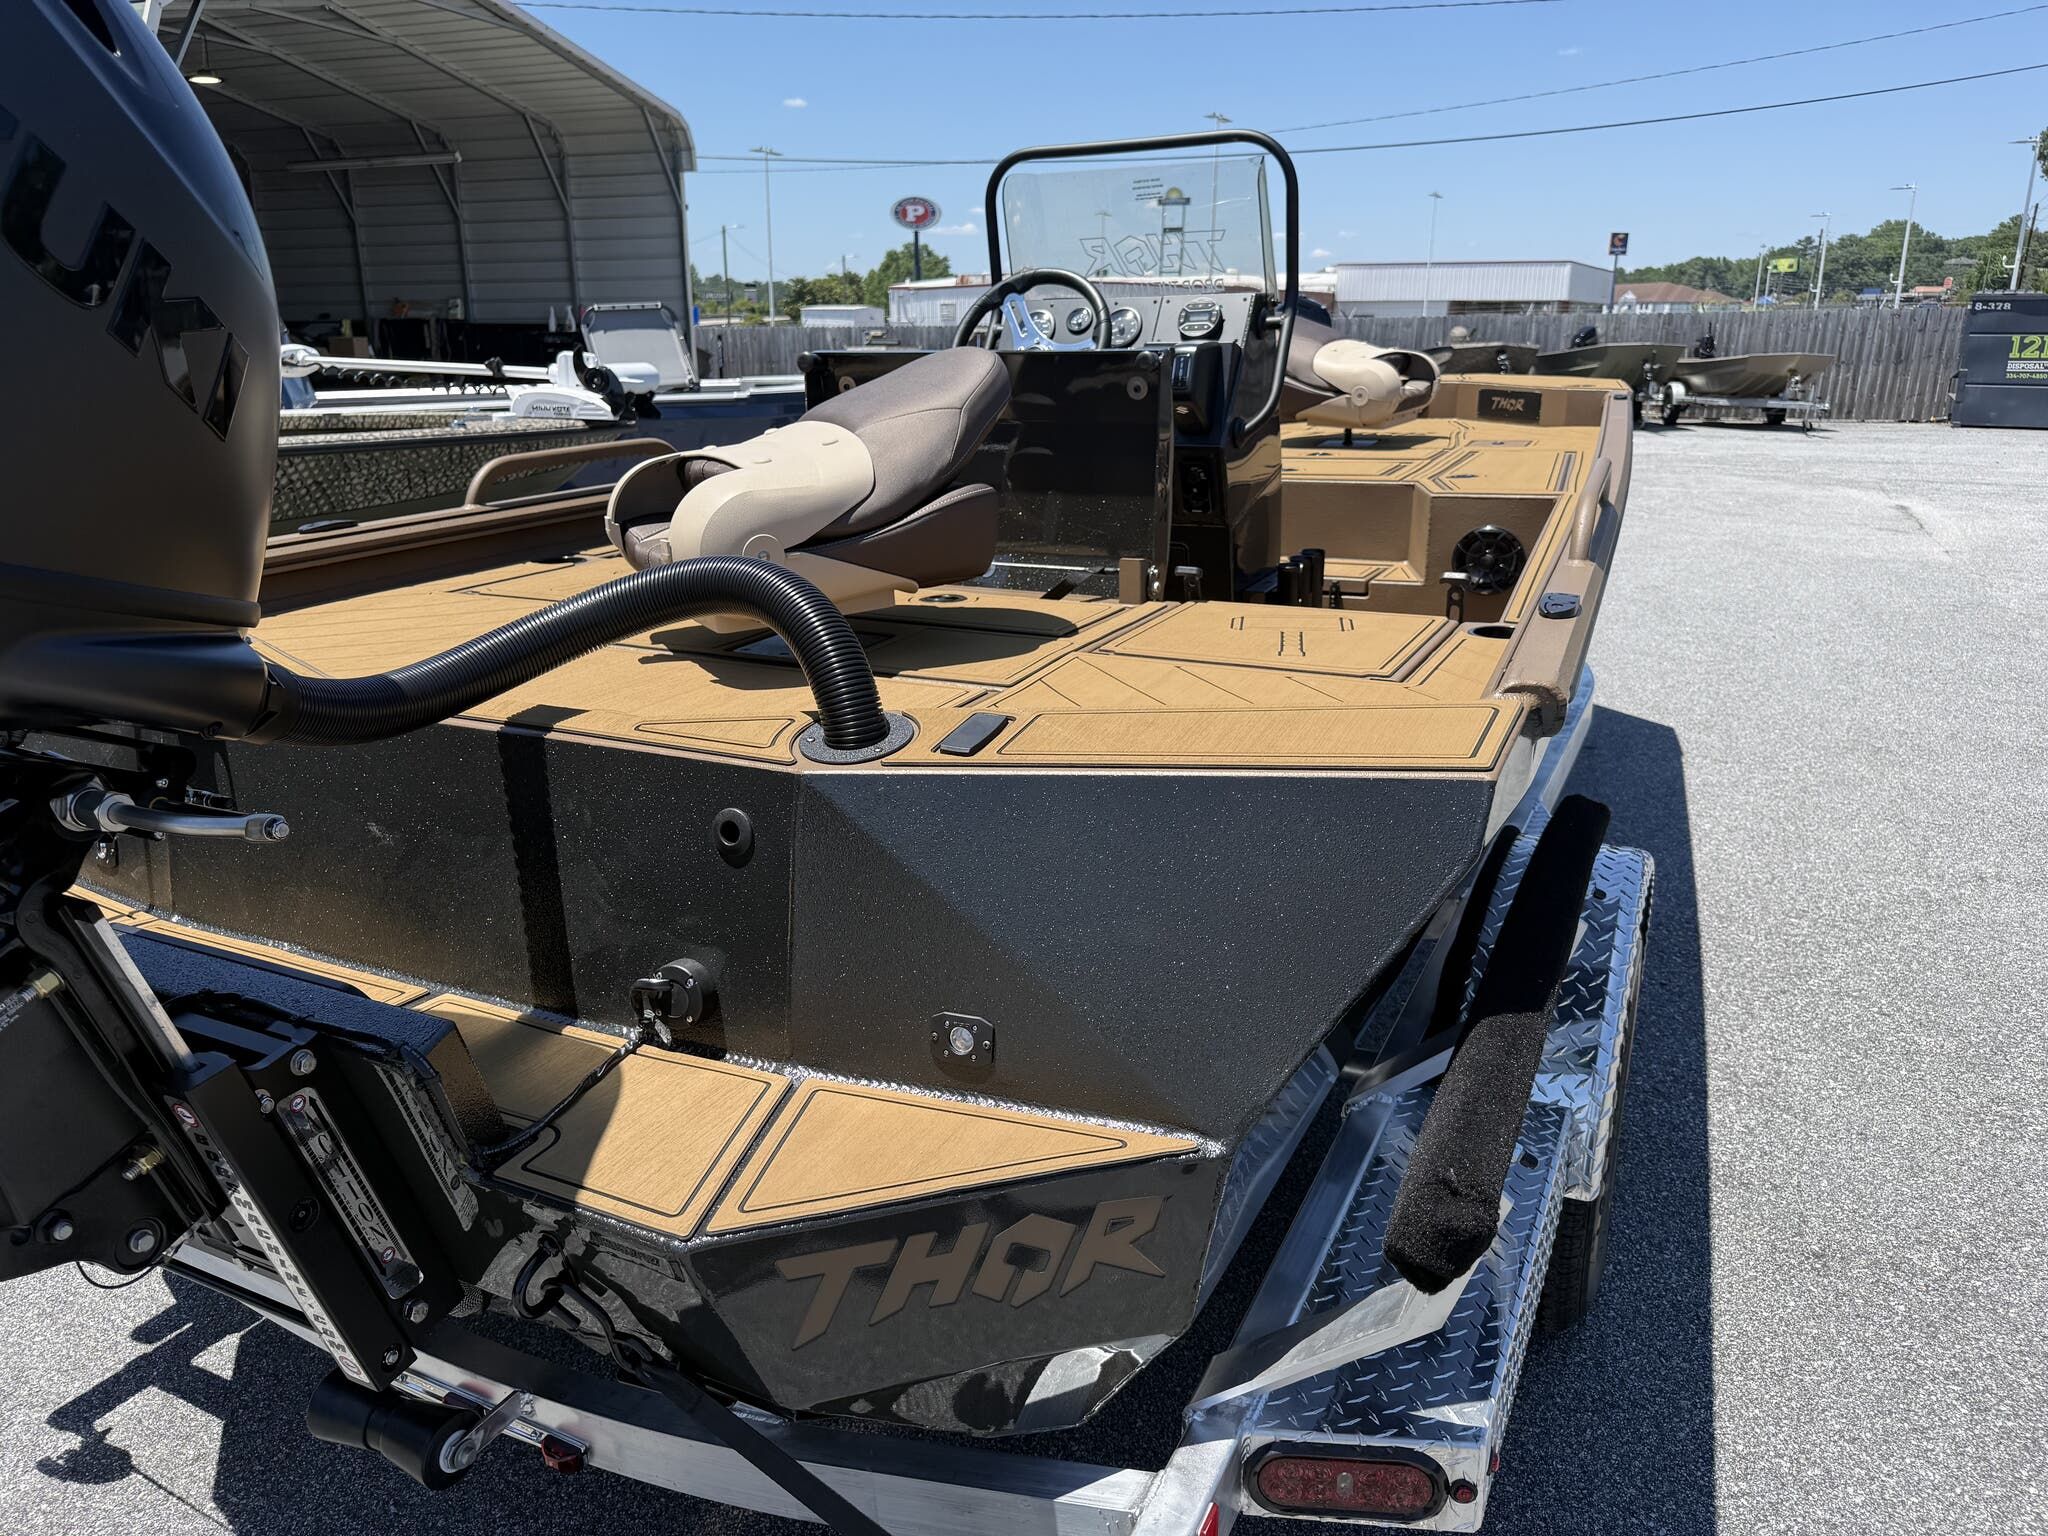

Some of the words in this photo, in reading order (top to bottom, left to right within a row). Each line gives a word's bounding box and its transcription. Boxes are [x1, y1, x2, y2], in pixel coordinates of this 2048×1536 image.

[0, 104, 250, 442] UKI
[1974, 302, 2012, 311] 8-378
[1491, 396, 1525, 411] THOR
[774, 1195, 1166, 1350] THOR
